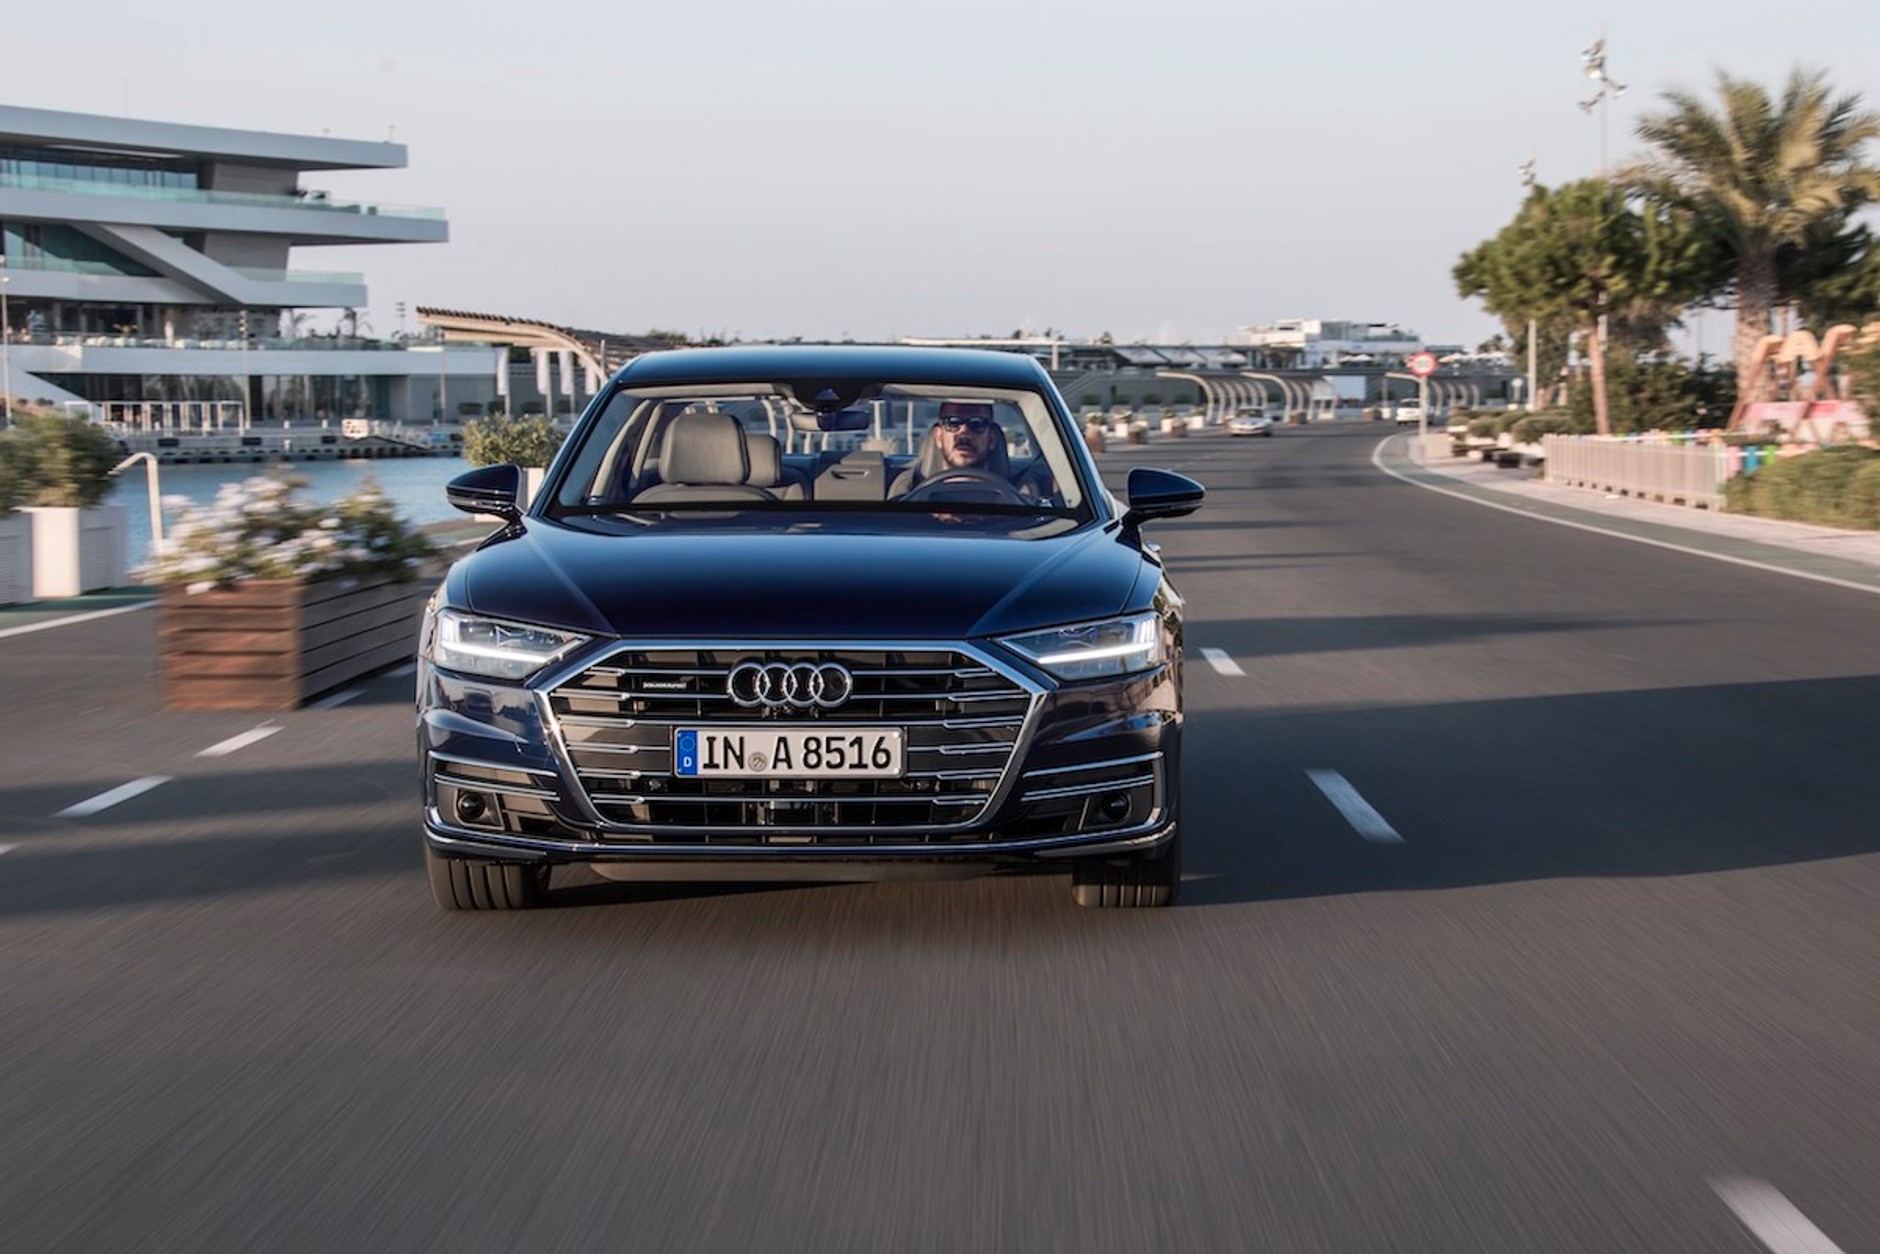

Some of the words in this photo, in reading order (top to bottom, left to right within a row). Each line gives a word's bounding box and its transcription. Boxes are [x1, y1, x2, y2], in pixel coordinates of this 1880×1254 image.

[683, 756, 692, 768] D
[703, 736, 745, 769] IN
[772, 736, 793, 769] A
[803, 736, 891, 769] 8516
